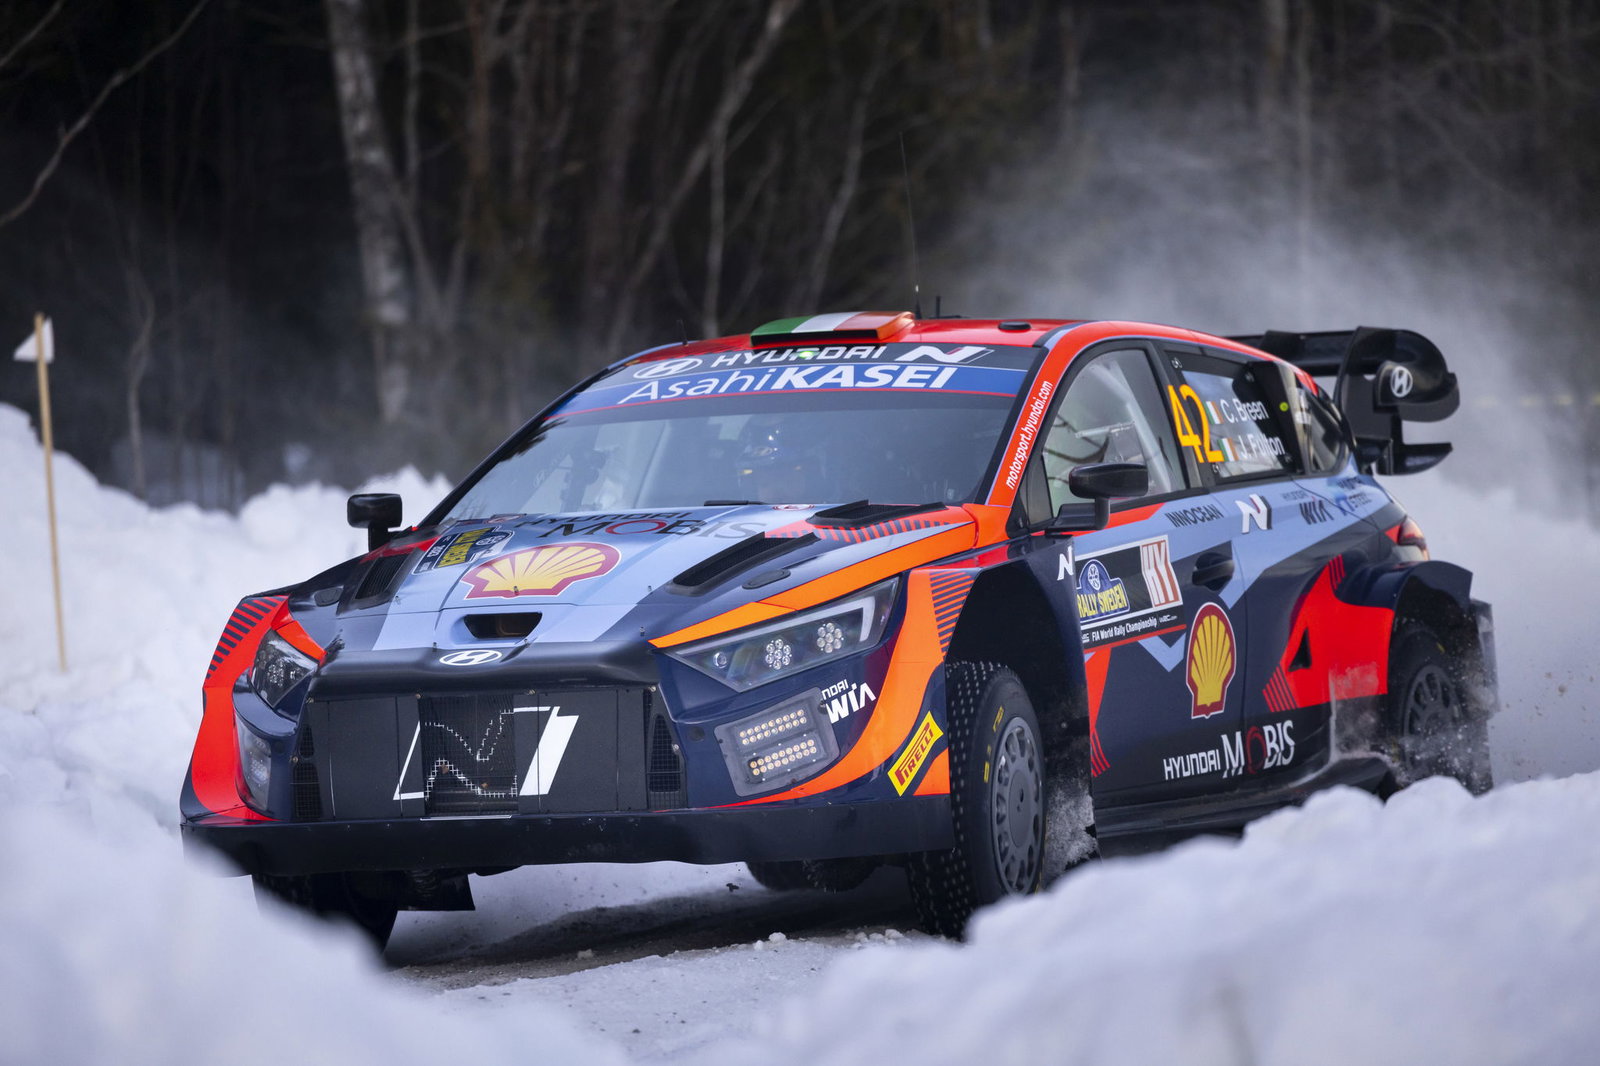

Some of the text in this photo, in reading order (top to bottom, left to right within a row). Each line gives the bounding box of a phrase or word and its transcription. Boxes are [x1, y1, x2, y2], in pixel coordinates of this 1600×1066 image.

[1167, 384, 1225, 463] 42
[1220, 398, 1270, 424] C. Breen
[1006, 380, 1053, 490] motorsport.hyundai.com
[1238, 433, 1286, 460] J. Fulton
[536, 518, 768, 540] MOBIS
[1165, 503, 1225, 528] INNOCEAN
[1097, 583, 1128, 613] SWEDEN
[1091, 630, 1101, 642] FIA
[1099, 624, 1115, 640] World
[1113, 622, 1126, 637] Rally
[1125, 614, 1158, 634] Championship
[894, 722, 934, 787] PIRELLI
[1163, 719, 1296, 780] HYUNDAI MOBIS
